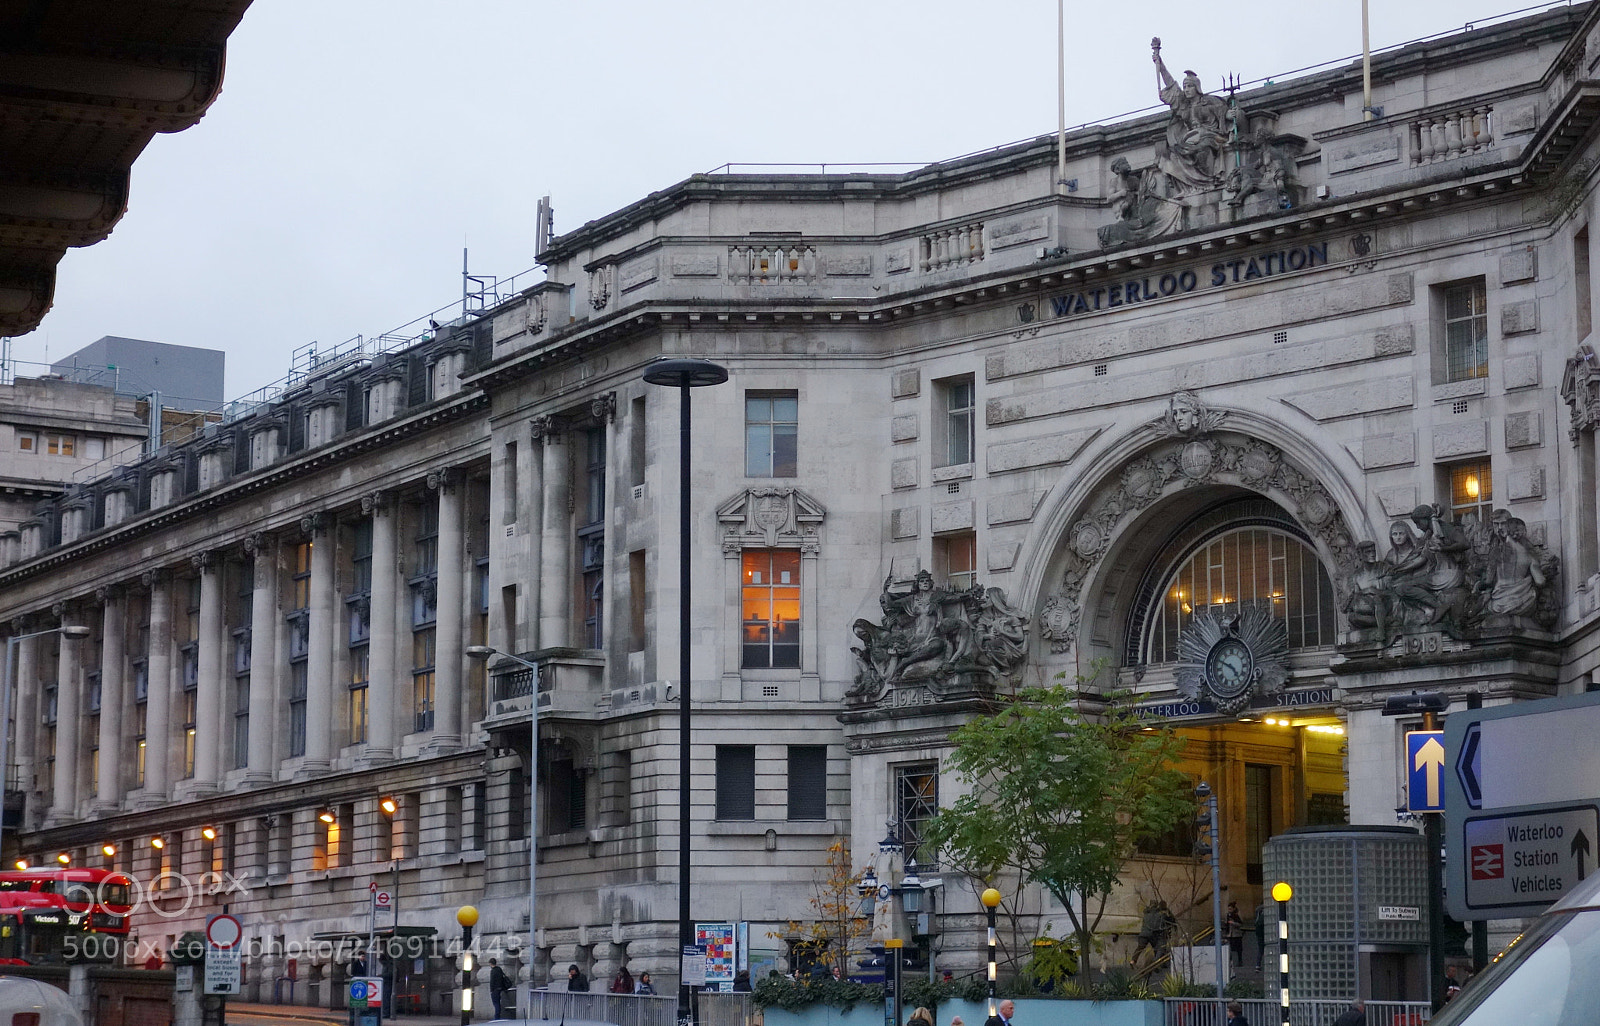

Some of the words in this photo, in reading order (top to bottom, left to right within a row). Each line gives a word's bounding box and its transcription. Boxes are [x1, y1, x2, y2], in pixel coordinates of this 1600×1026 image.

[1051, 271, 1197, 317] WATERLOO
[1211, 243, 1328, 286] STATION
[894, 689, 919, 707] 1914
[1132, 702, 1199, 719] WATERLOO
[1277, 690, 1331, 706] STATION
[1508, 823, 1563, 842] Waterloo
[1514, 850, 1558, 867] Station
[1512, 875, 1562, 893] Vehicles
[68, 916, 80, 924] 507
